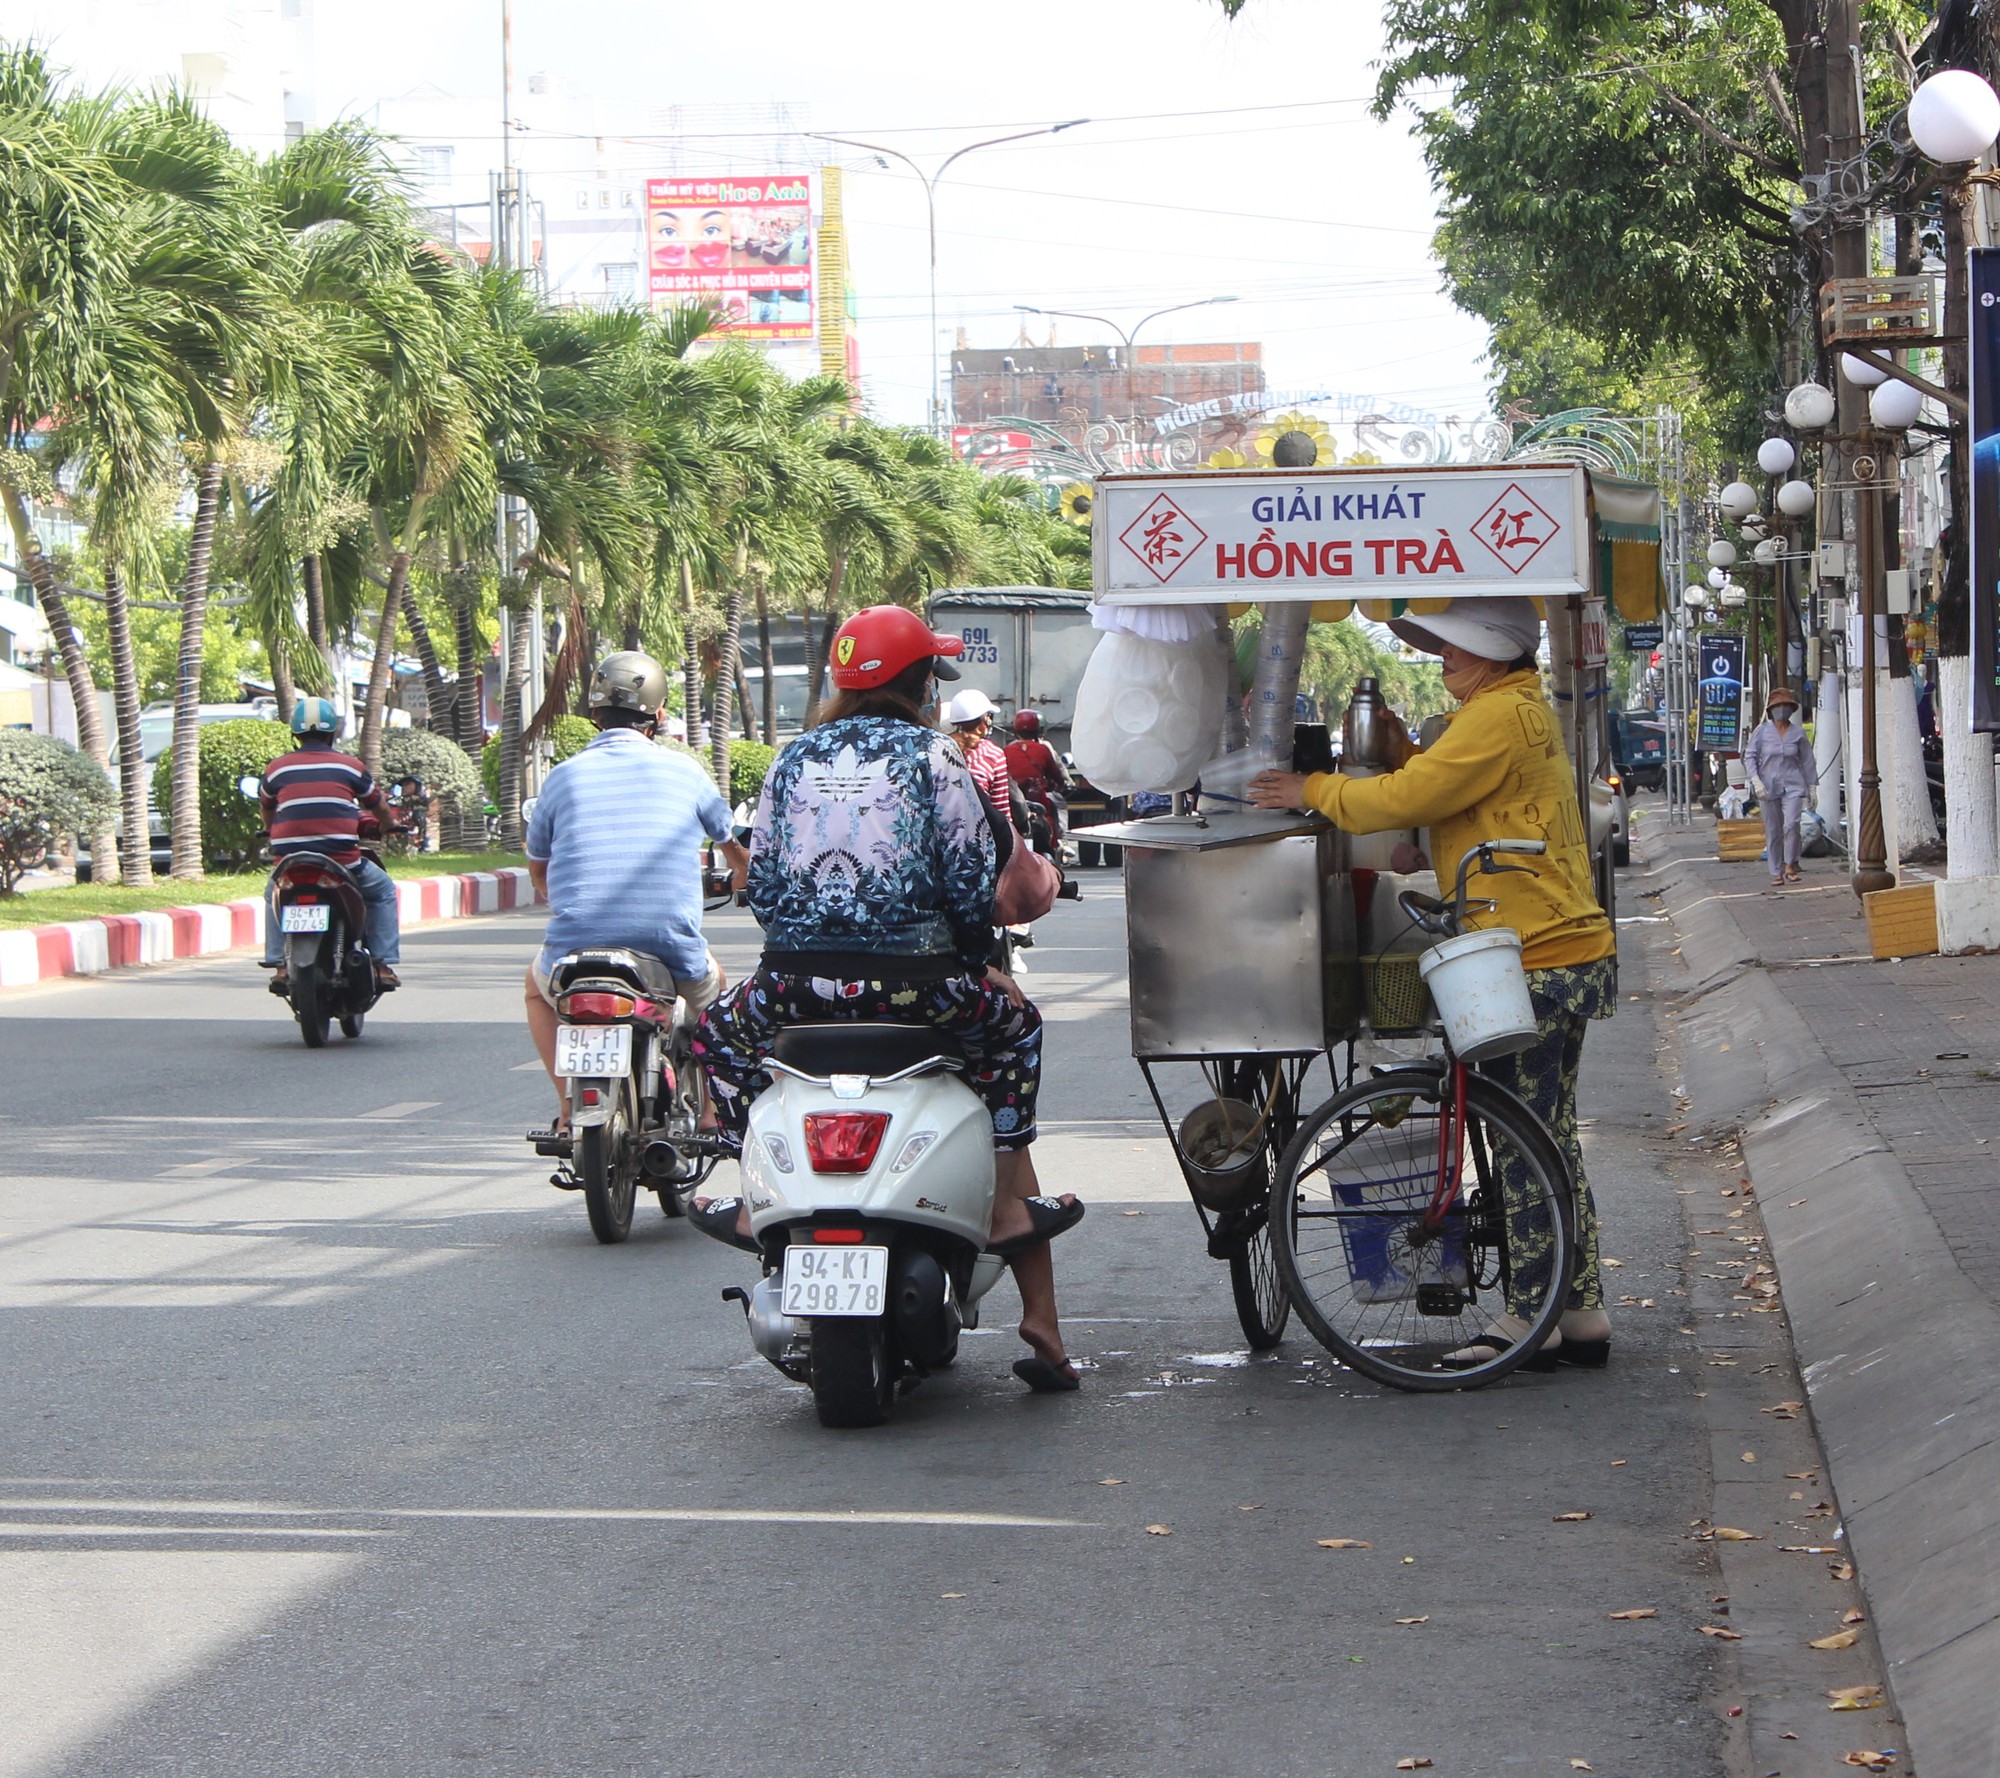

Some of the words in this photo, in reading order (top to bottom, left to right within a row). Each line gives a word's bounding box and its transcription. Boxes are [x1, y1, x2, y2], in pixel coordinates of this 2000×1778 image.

[764, 180, 807, 201] Anh
[1252, 486, 1322, 522] GIẢI
[1333, 484, 1426, 520] KHÁT
[1142, 510, 1184, 564] 茶
[1216, 528, 1352, 578] HỒNG
[1364, 528, 1465, 576] TRÀ
[962, 627, 992, 645] 69L
[569, 1028, 620, 1049] 94-F1
[567, 1053, 619, 1073] 5655
[801, 1252, 869, 1279] 94-K1
[788, 1283, 879, 1311] 298.78
